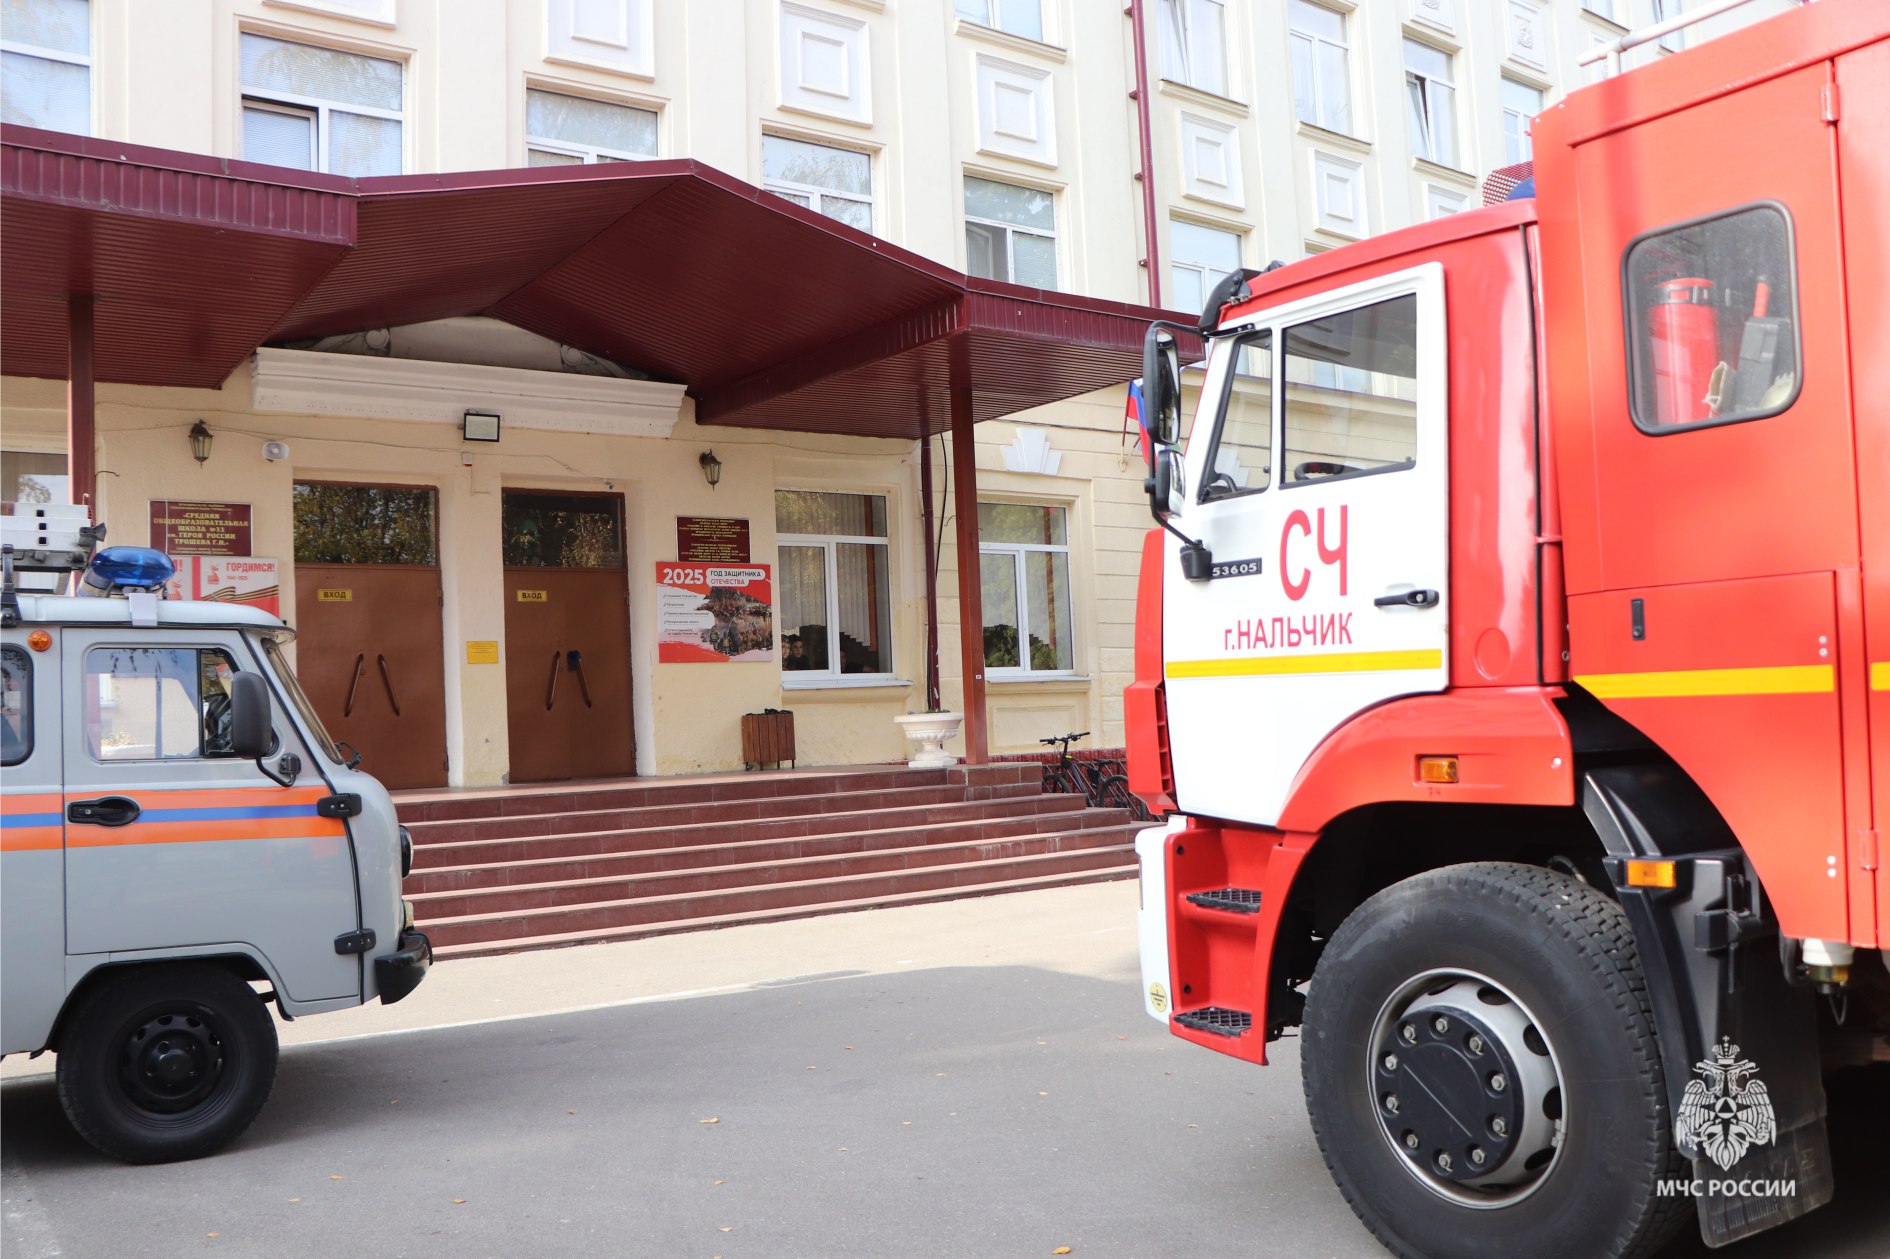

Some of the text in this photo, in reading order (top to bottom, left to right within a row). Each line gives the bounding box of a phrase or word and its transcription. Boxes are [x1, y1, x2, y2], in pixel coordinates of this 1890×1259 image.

[153, 518, 249, 527] ОБЩЕОБРАЗОВАТЕЛЬНАЯ
[1279, 504, 1349, 602] СЧ
[226, 562, 275, 573] ГОРДИМСЯ!
[1212, 562, 1257, 577] 53605
[663, 568, 704, 585] 2025
[323, 591, 347, 599] ВХОД
[521, 592, 542, 600] ВХОД
[1224, 612, 1353, 651] г.НАЛЬЧИК
